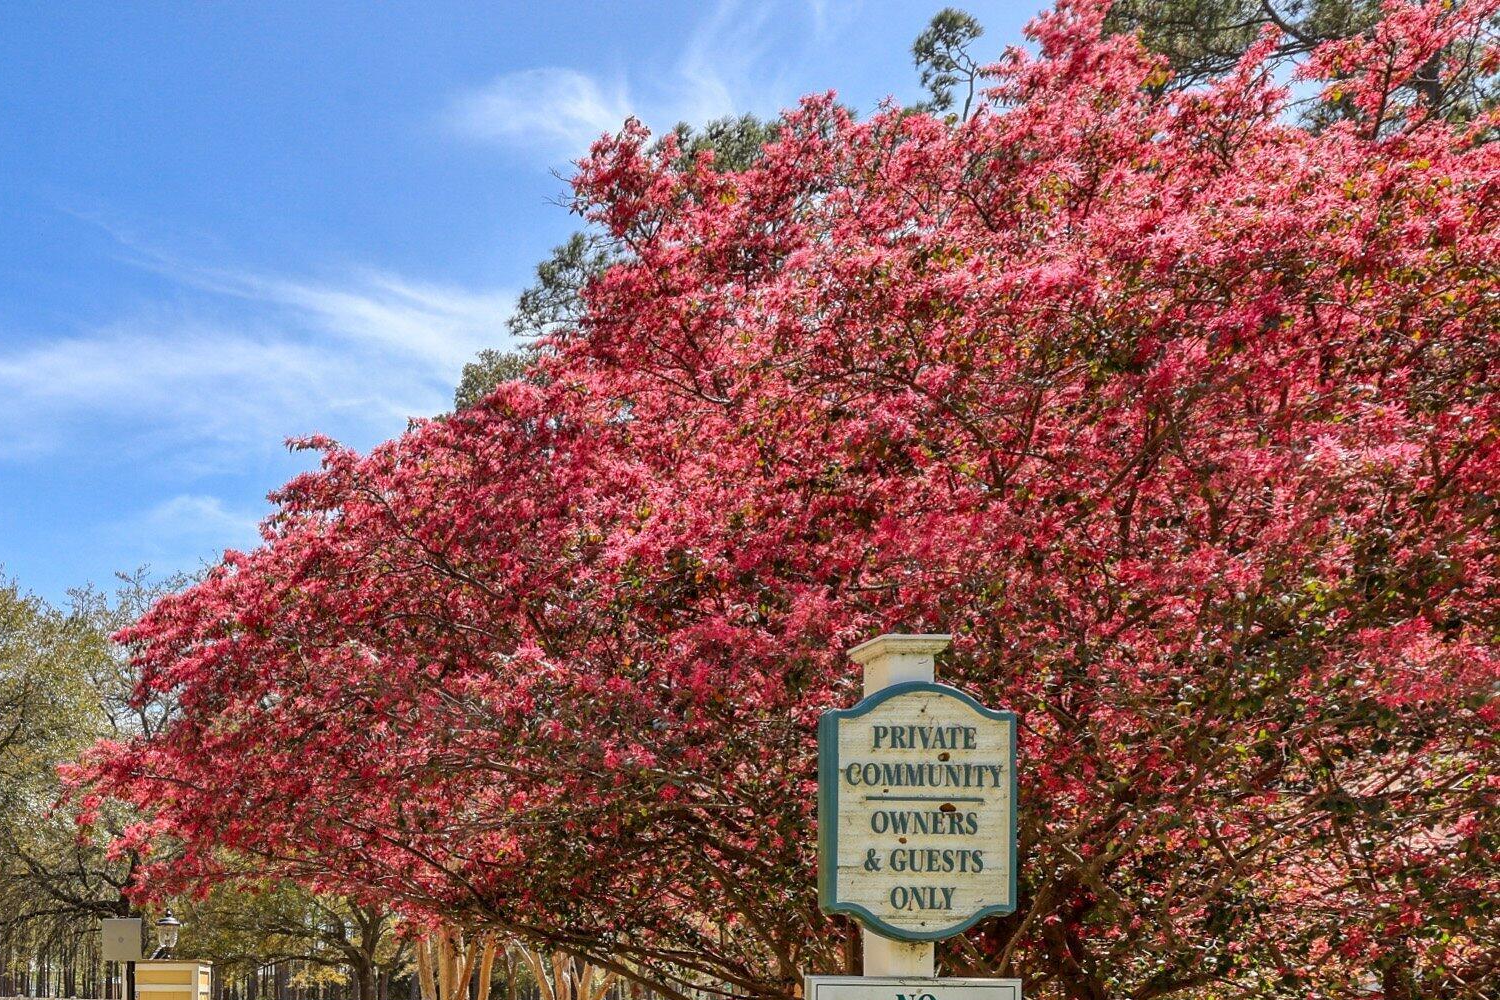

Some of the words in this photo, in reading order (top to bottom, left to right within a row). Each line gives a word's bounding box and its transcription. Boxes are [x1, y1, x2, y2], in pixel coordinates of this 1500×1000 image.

[873, 725, 977, 750] PRIVATE
[846, 762, 1003, 788] COMMUNITY
[871, 811, 978, 835] OWNERS
[864, 848, 881, 872] &
[889, 849, 984, 873] GUESTS
[890, 886, 956, 911] ONLY
